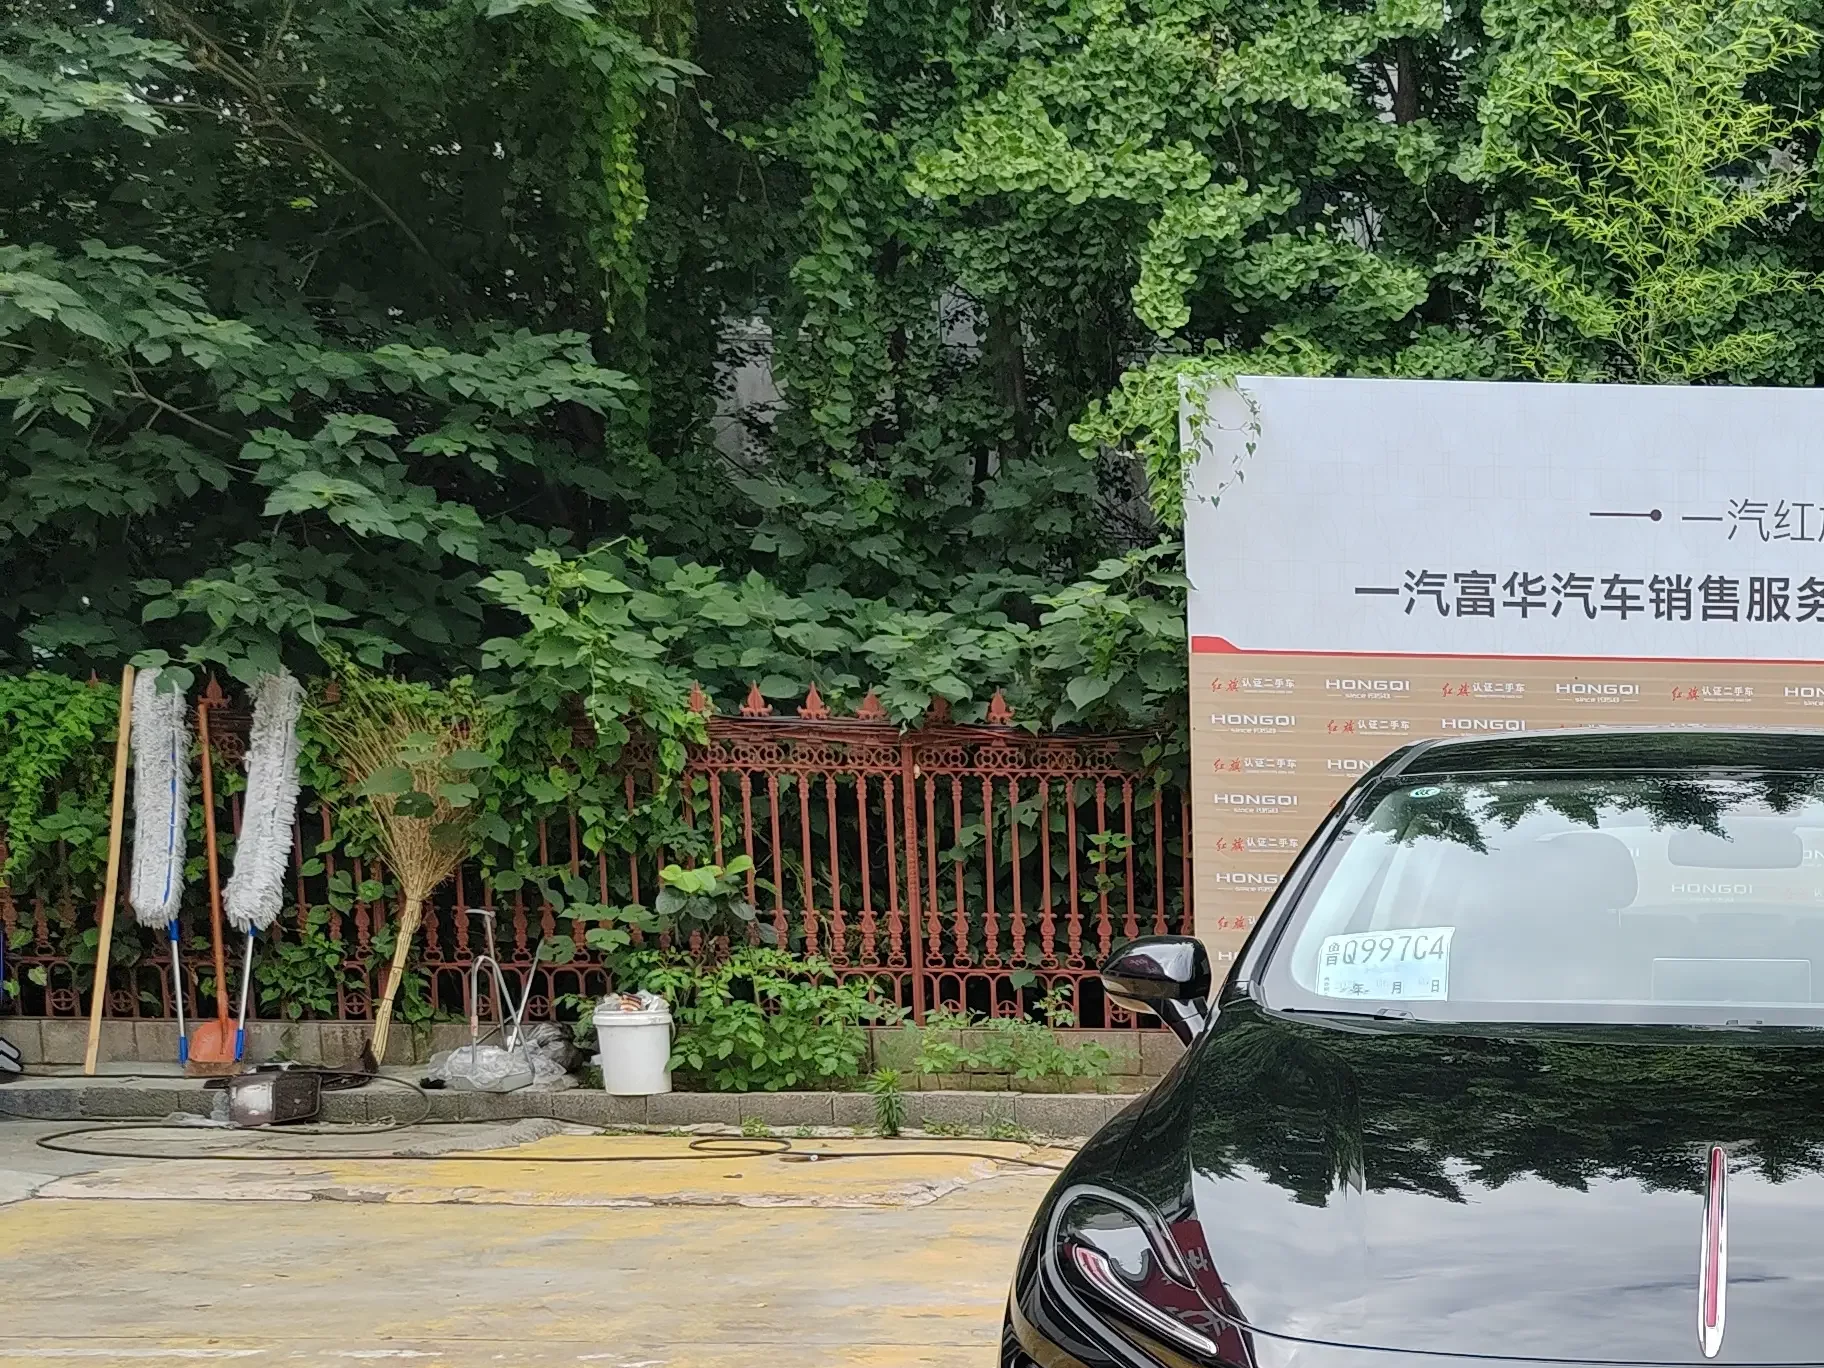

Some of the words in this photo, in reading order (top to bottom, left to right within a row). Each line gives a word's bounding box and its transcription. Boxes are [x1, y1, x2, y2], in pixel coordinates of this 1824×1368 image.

[1242, 678, 1294, 688] 认证二手车
[1326, 680, 1409, 690] HONGQI
[1473, 683, 1524, 692] 认证二手车
[1556, 684, 1638, 695] HONGQI
[1702, 686, 1753, 696] 认证二手车
[1212, 714, 1295, 725] HONGQI
[1358, 720, 1409, 729] 认证二手车
[1442, 719, 1525, 730] HONGQI
[1244, 758, 1296, 768] 认证二手车
[1327, 759, 1373, 770] HON
[1215, 794, 1297, 805] HONGQI
[1247, 838, 1298, 847] 认证二手车
[1216, 873, 1280, 883] HONG
[1672, 884, 1752, 894] HONGQI
[1326, 935, 1444, 967] 鲁Q997C4
